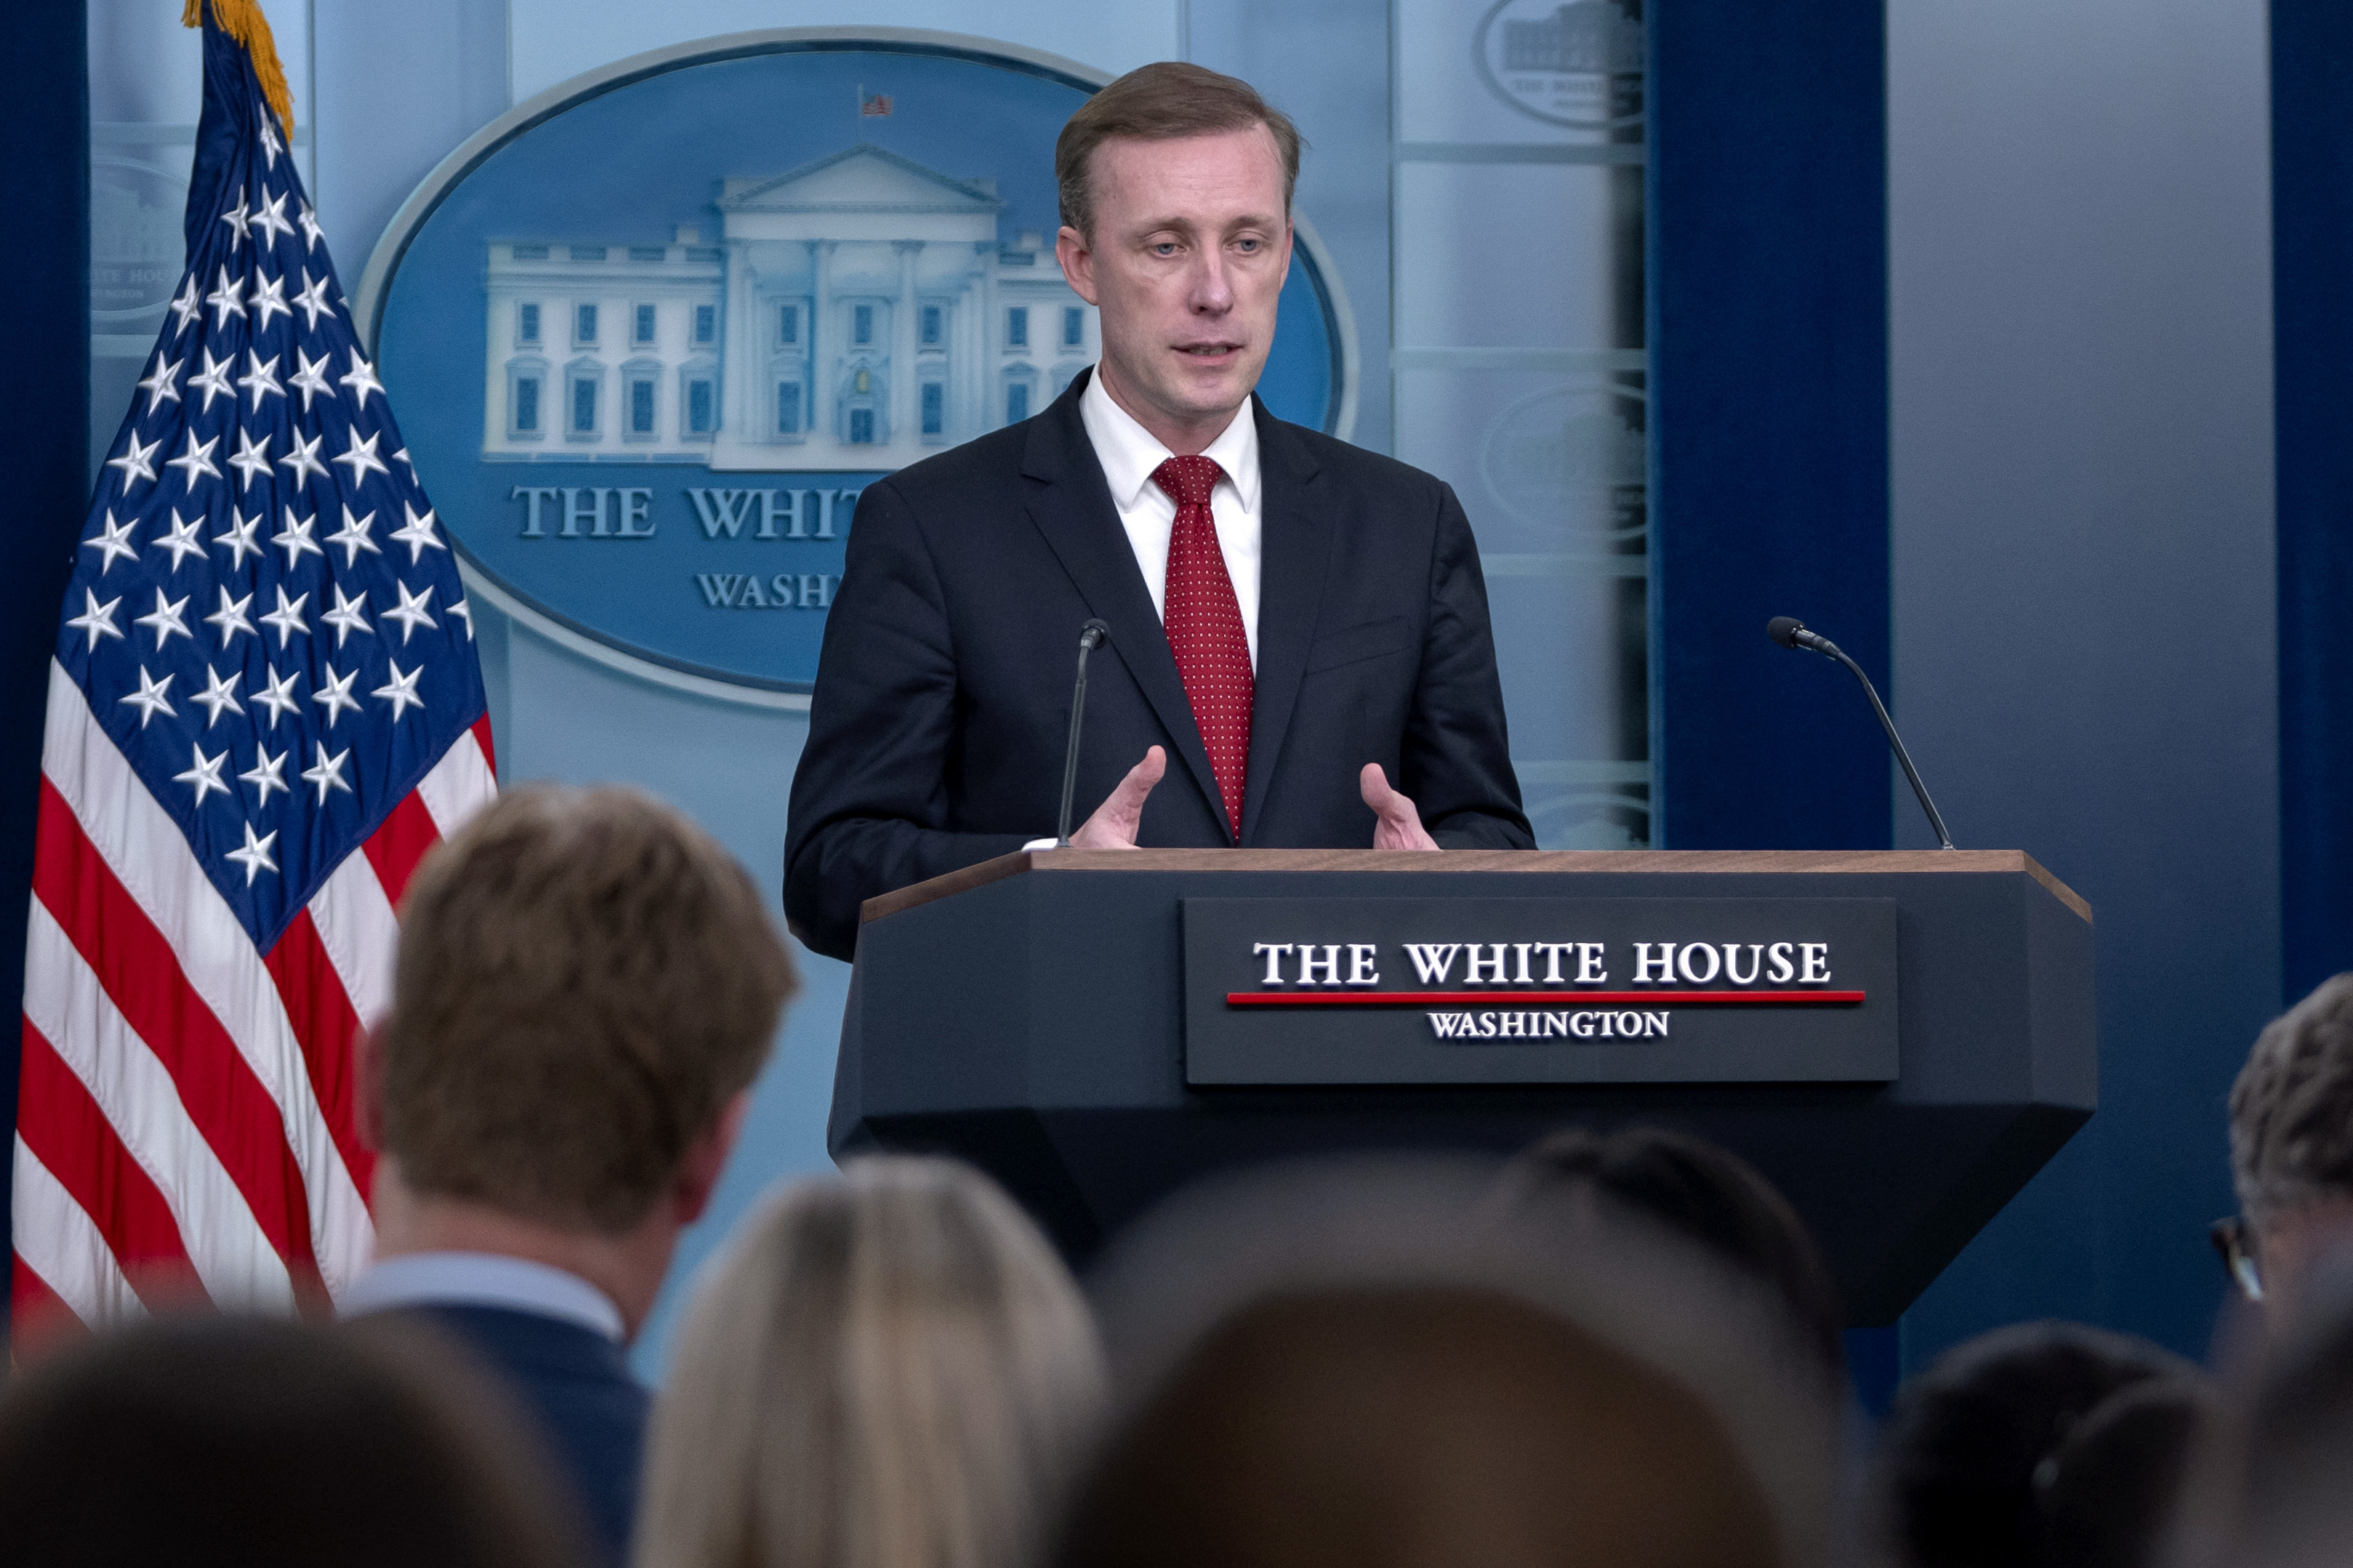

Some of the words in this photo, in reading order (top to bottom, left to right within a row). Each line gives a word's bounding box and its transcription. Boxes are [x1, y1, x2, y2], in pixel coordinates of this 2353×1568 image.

[512, 486, 655, 537] THE
[686, 487, 862, 539] WHI
[1252, 942, 1380, 985] THE
[1401, 941, 1608, 984] WHITE
[1631, 941, 1832, 984] HOUSE
[1425, 1010, 1670, 1039] WASHINGTON
